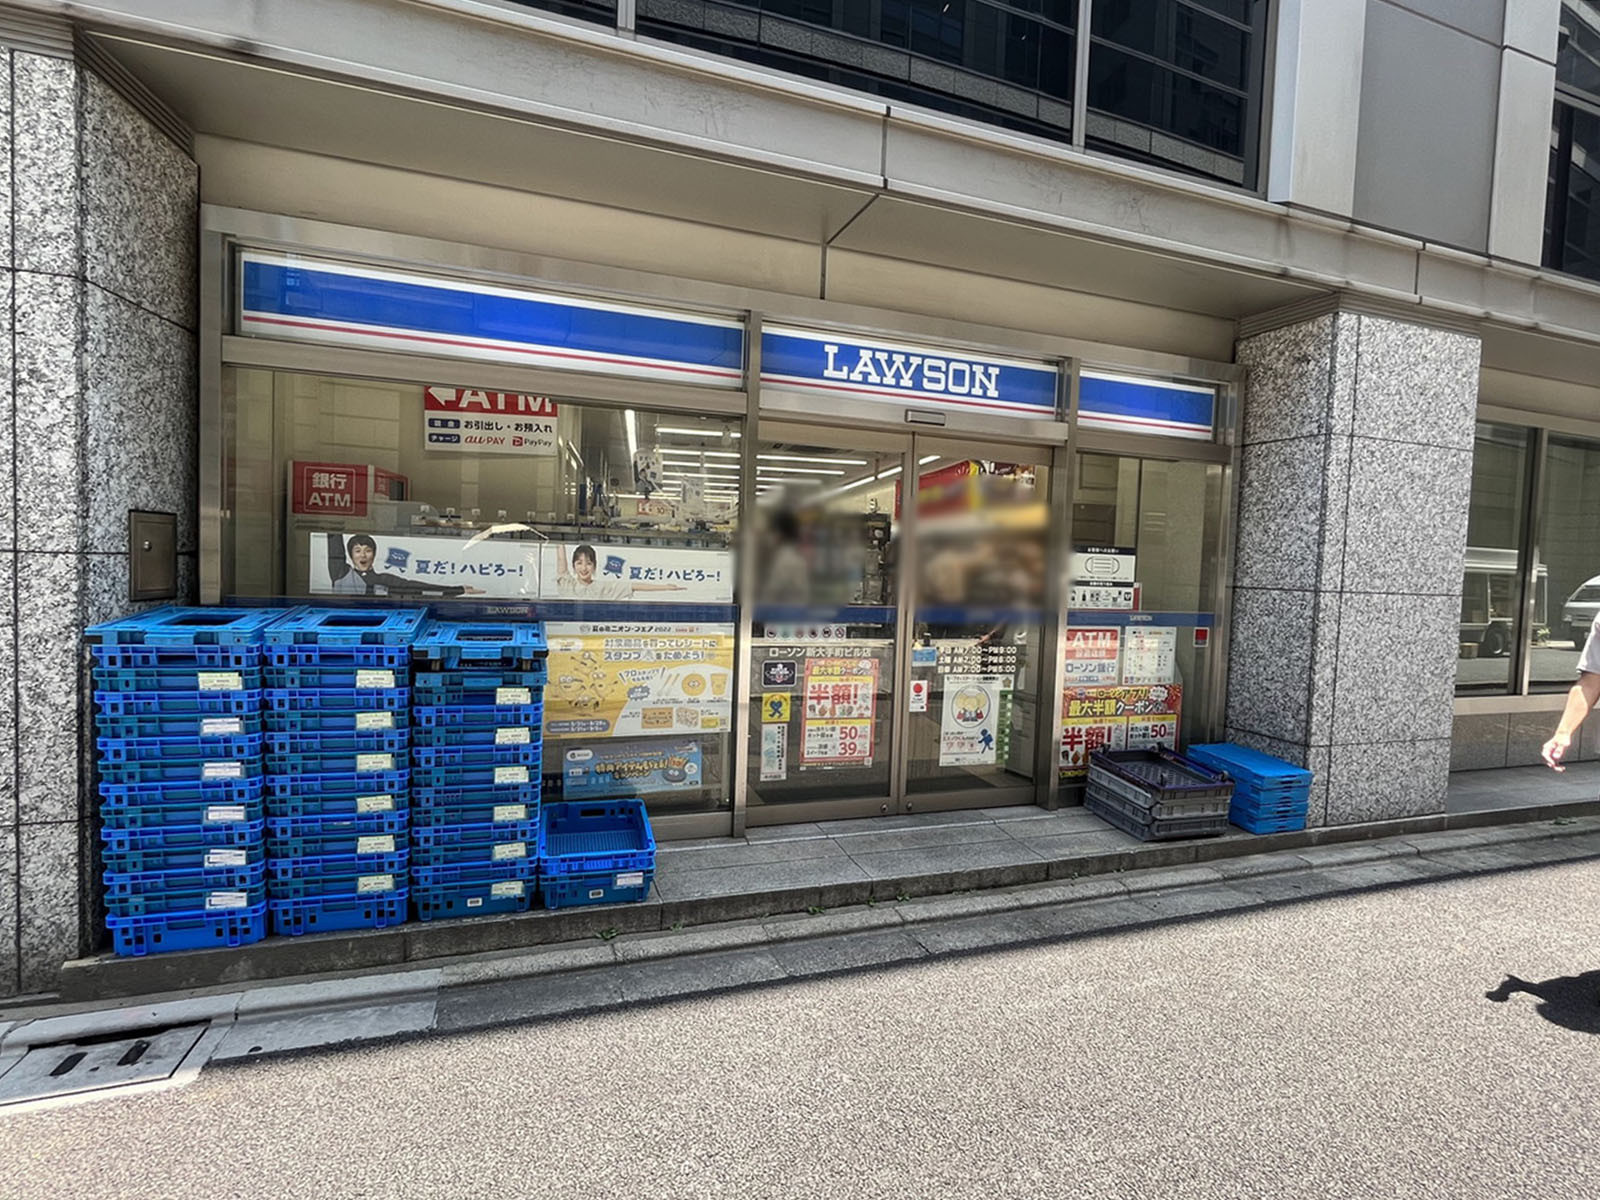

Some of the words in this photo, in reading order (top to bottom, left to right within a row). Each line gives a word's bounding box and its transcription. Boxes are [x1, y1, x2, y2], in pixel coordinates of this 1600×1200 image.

[823, 344, 1000, 398] LAWSON
[459, 389, 553, 412] ATM
[524, 437, 552, 448] PayPay
[312, 472, 347, 490] 銀行
[308, 492, 351, 507] ATM
[1071, 631, 1111, 648] ATM
[1065, 661, 1115, 673] ローソン銀行
[840, 726, 858, 740] 50
[1151, 723, 1167, 738] 50
[838, 742, 857, 756] 39
